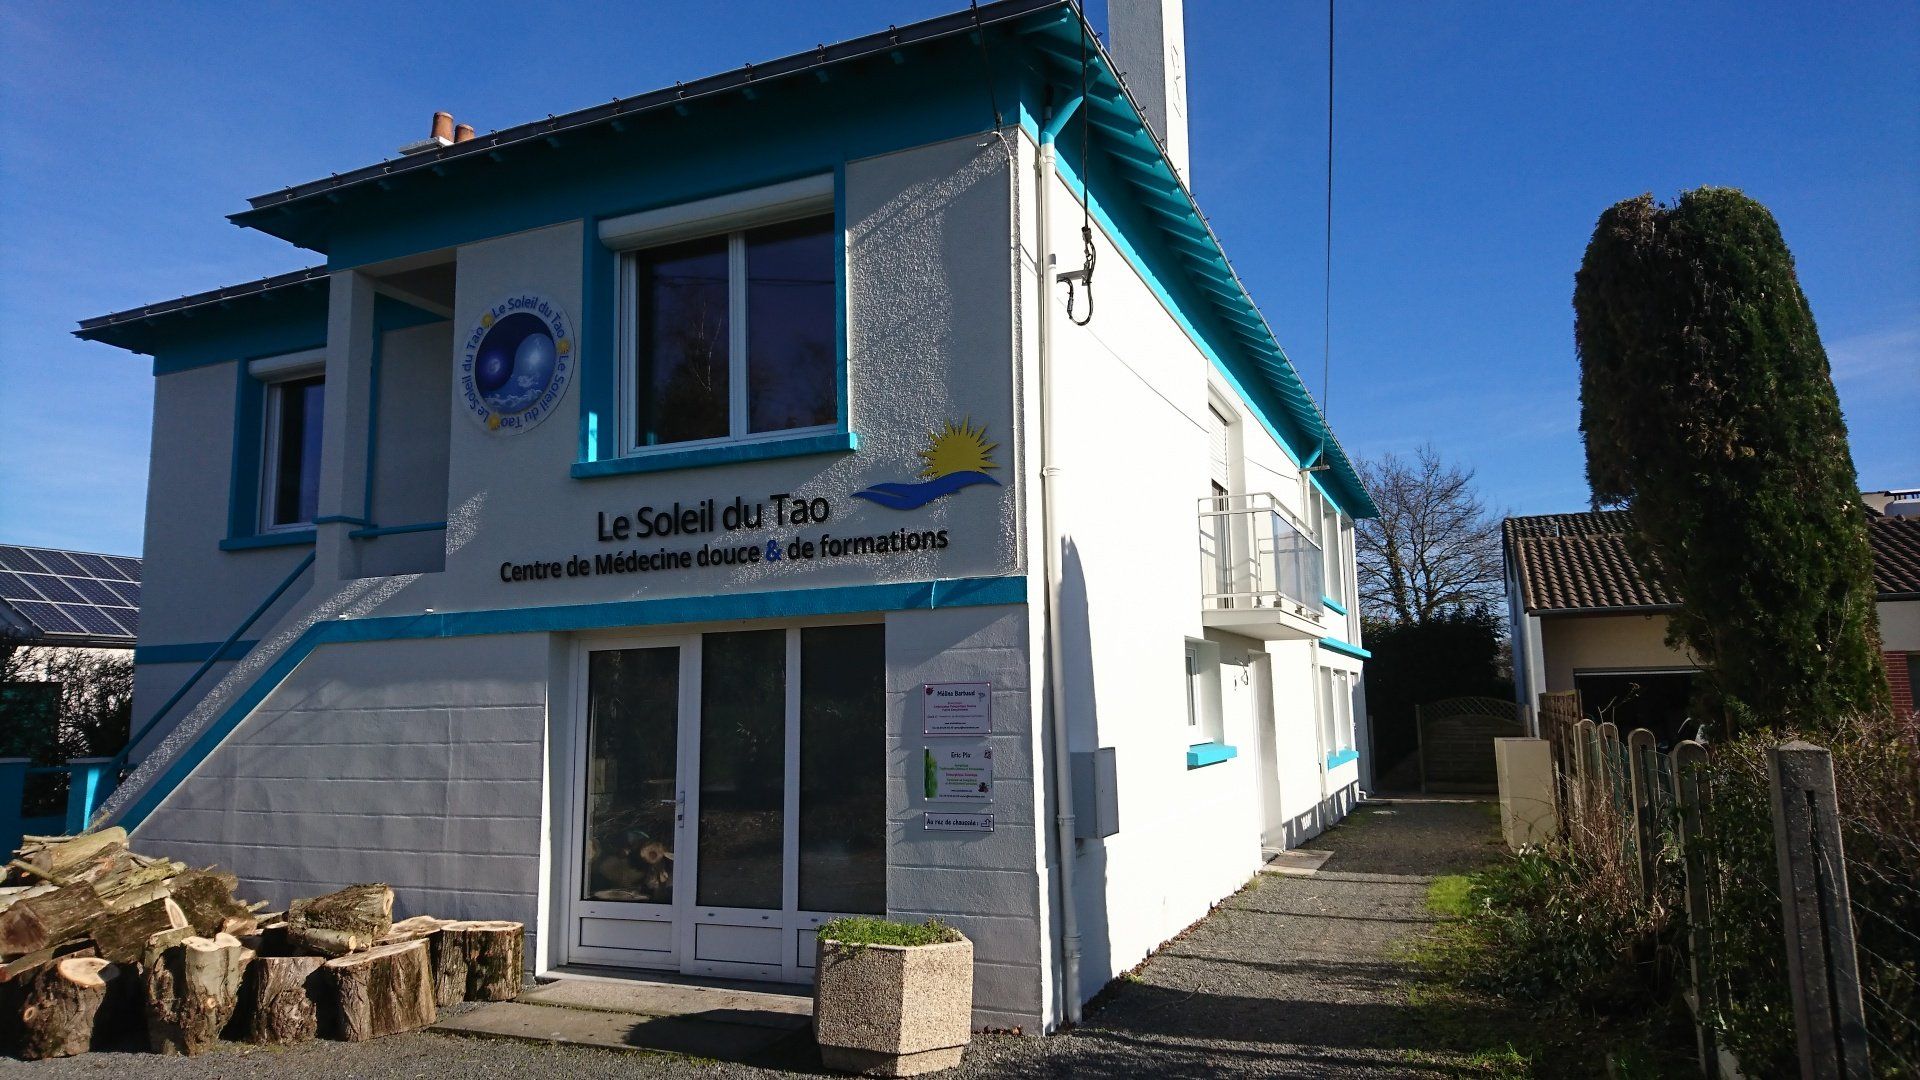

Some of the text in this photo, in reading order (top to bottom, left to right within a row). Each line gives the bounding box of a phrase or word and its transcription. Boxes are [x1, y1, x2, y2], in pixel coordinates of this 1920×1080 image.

[491, 295, 565, 338] Le Soleil du Tao
[462, 326, 490, 423] Le Soleil du Tao
[501, 355, 569, 428] Le Soleil du Tao
[598, 493, 830, 541] Le Soleil du Tao
[500, 528, 948, 582] Centre de Médecine douce & de formations
